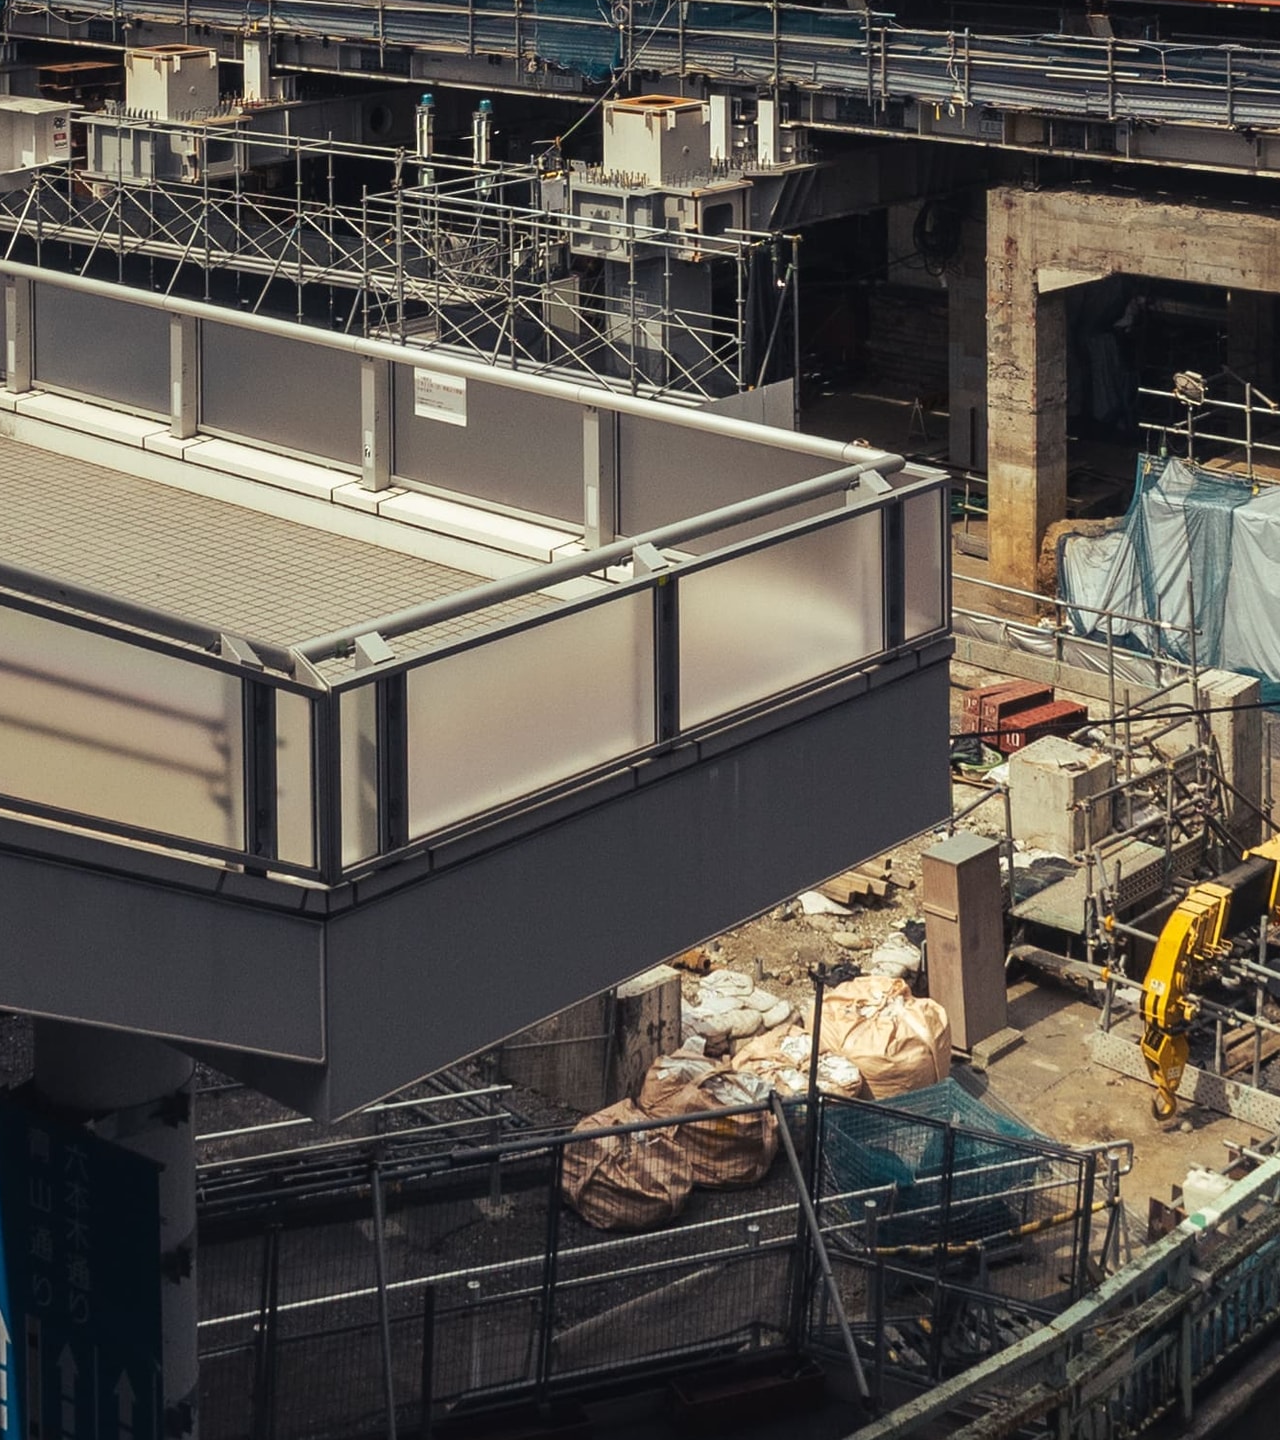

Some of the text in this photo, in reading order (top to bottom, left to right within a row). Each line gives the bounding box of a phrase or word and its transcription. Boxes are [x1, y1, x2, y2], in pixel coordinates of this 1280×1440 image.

[63, 1143, 93, 1324] 六本木通り
